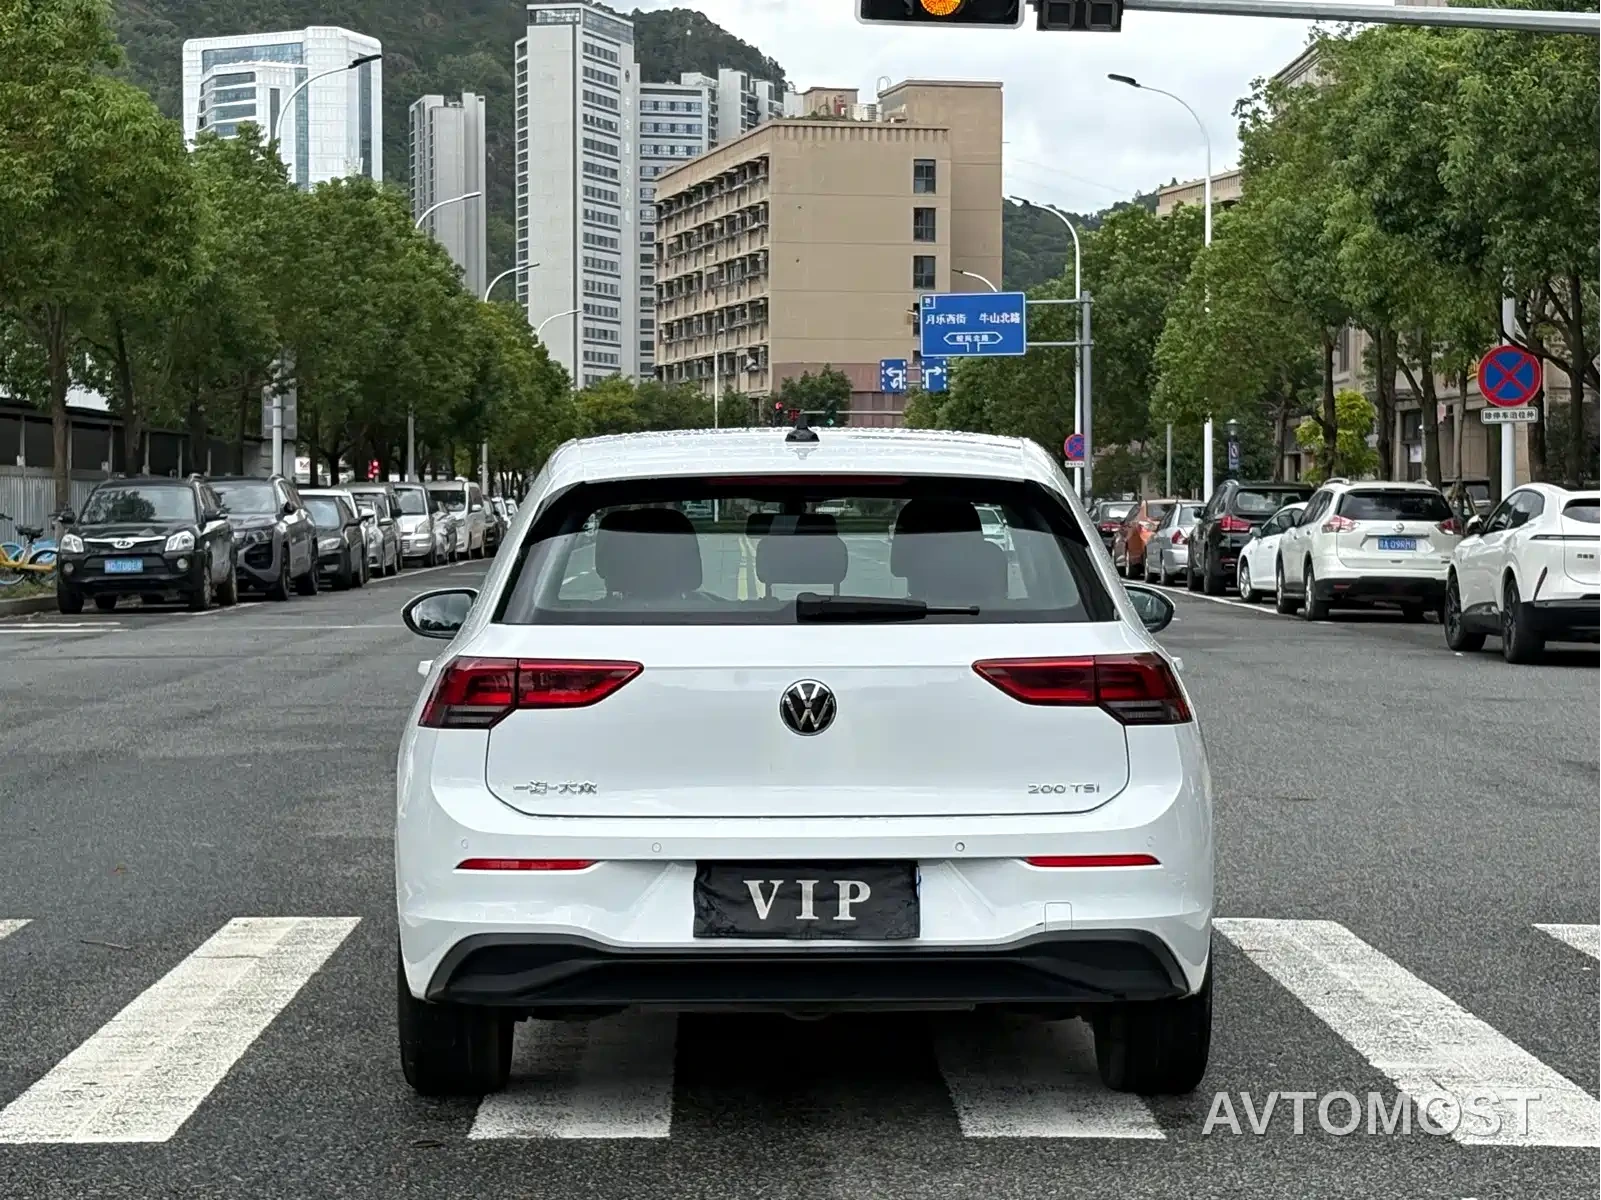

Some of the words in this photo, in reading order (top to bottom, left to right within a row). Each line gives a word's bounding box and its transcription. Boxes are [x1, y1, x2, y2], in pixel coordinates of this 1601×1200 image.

[1027, 783, 1067, 795] 200
[1069, 782, 1101, 794] TSI
[743, 879, 871, 921] VIP
